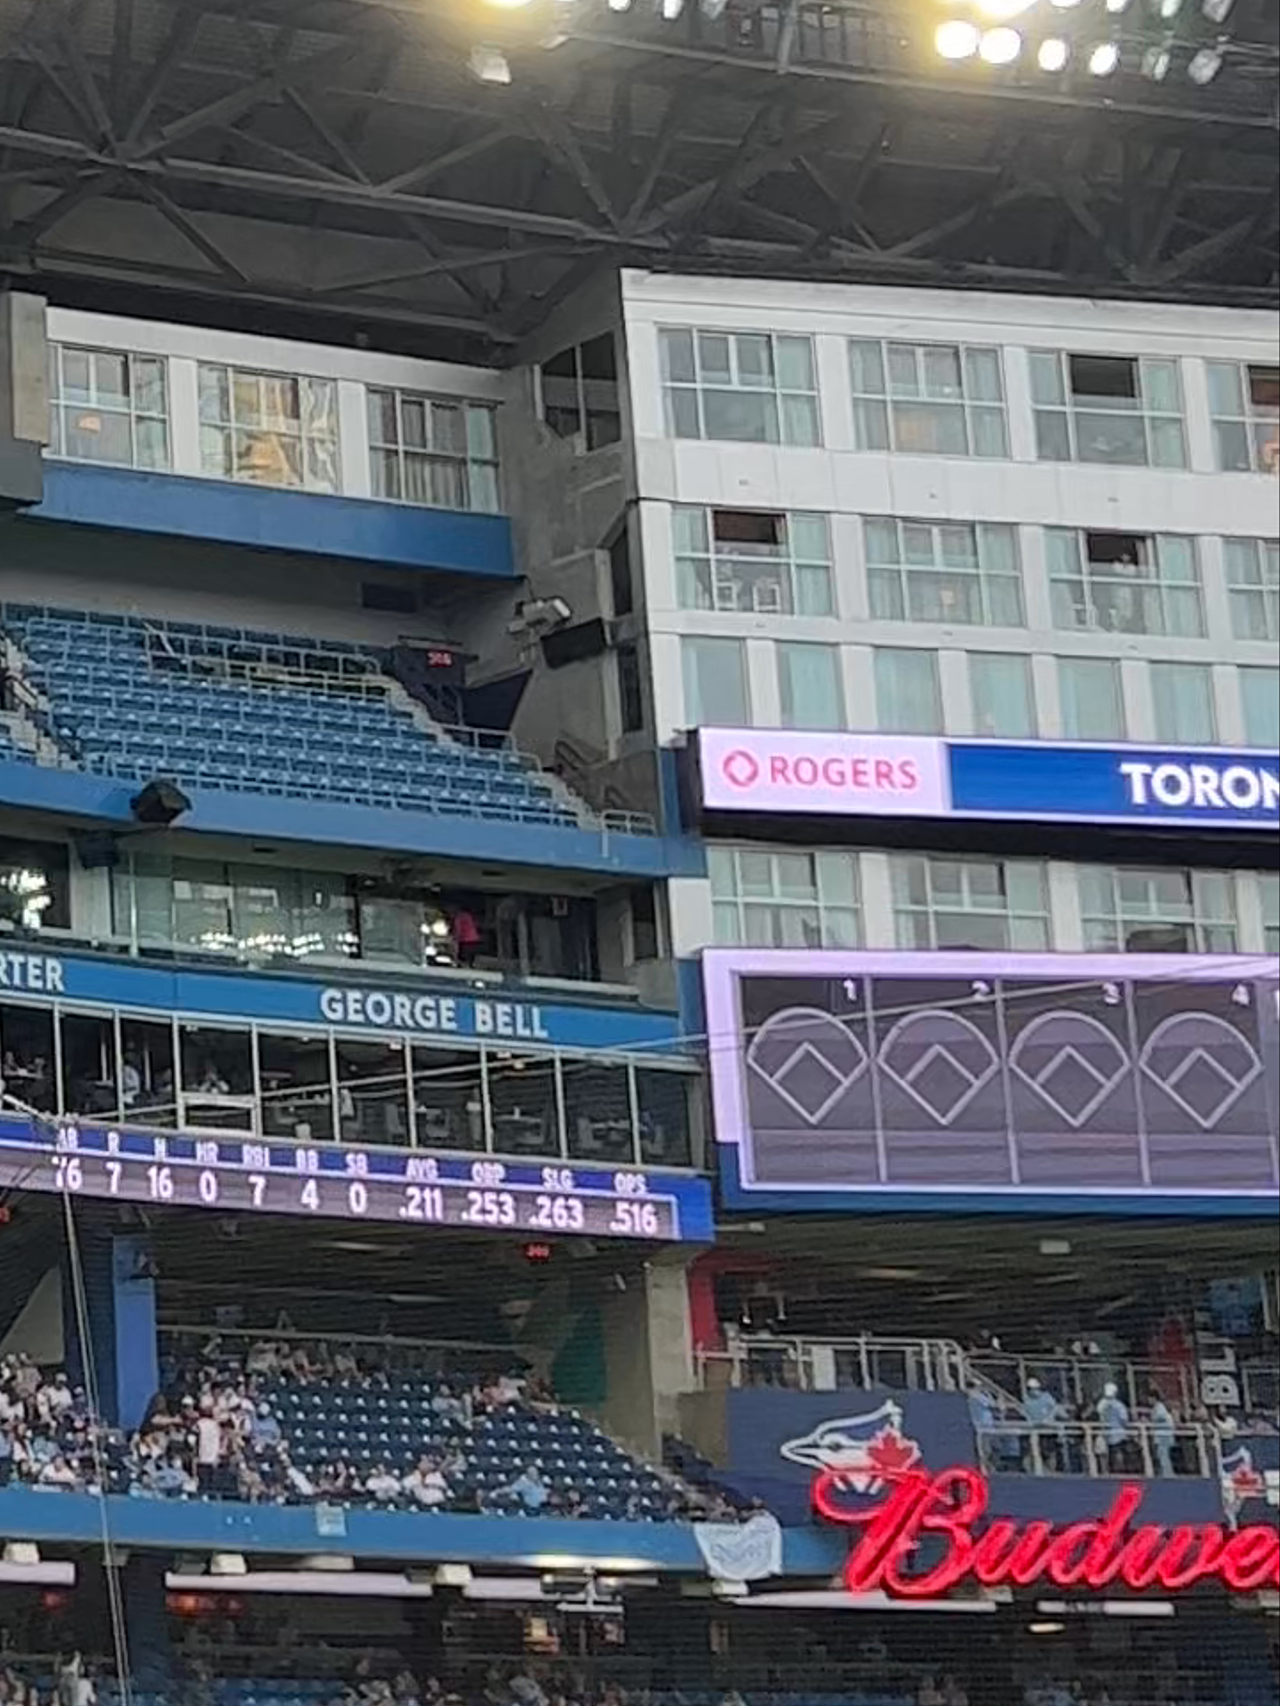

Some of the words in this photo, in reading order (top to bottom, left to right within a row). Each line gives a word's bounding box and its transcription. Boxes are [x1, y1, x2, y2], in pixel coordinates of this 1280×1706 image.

[769, 755, 919, 789] ROGERS
[320, 989, 458, 1031] GEORGE
[475, 1000, 548, 1038] BELL
[406, 1158, 438, 1181] AVG
[543, 1167, 574, 1190] SLG
[106, 1162, 122, 1194] 7
[147, 1166, 173, 1199] 16
[199, 1170, 218, 1202] 0
[248, 1175, 266, 1207] 7
[301, 1178, 320, 1211] 4
[349, 1182, 367, 1214] 0
[399, 1187, 443, 1220] .211
[461, 1191, 515, 1225] .253
[529, 1196, 584, 1229] .263
[609, 1201, 657, 1234] .516
